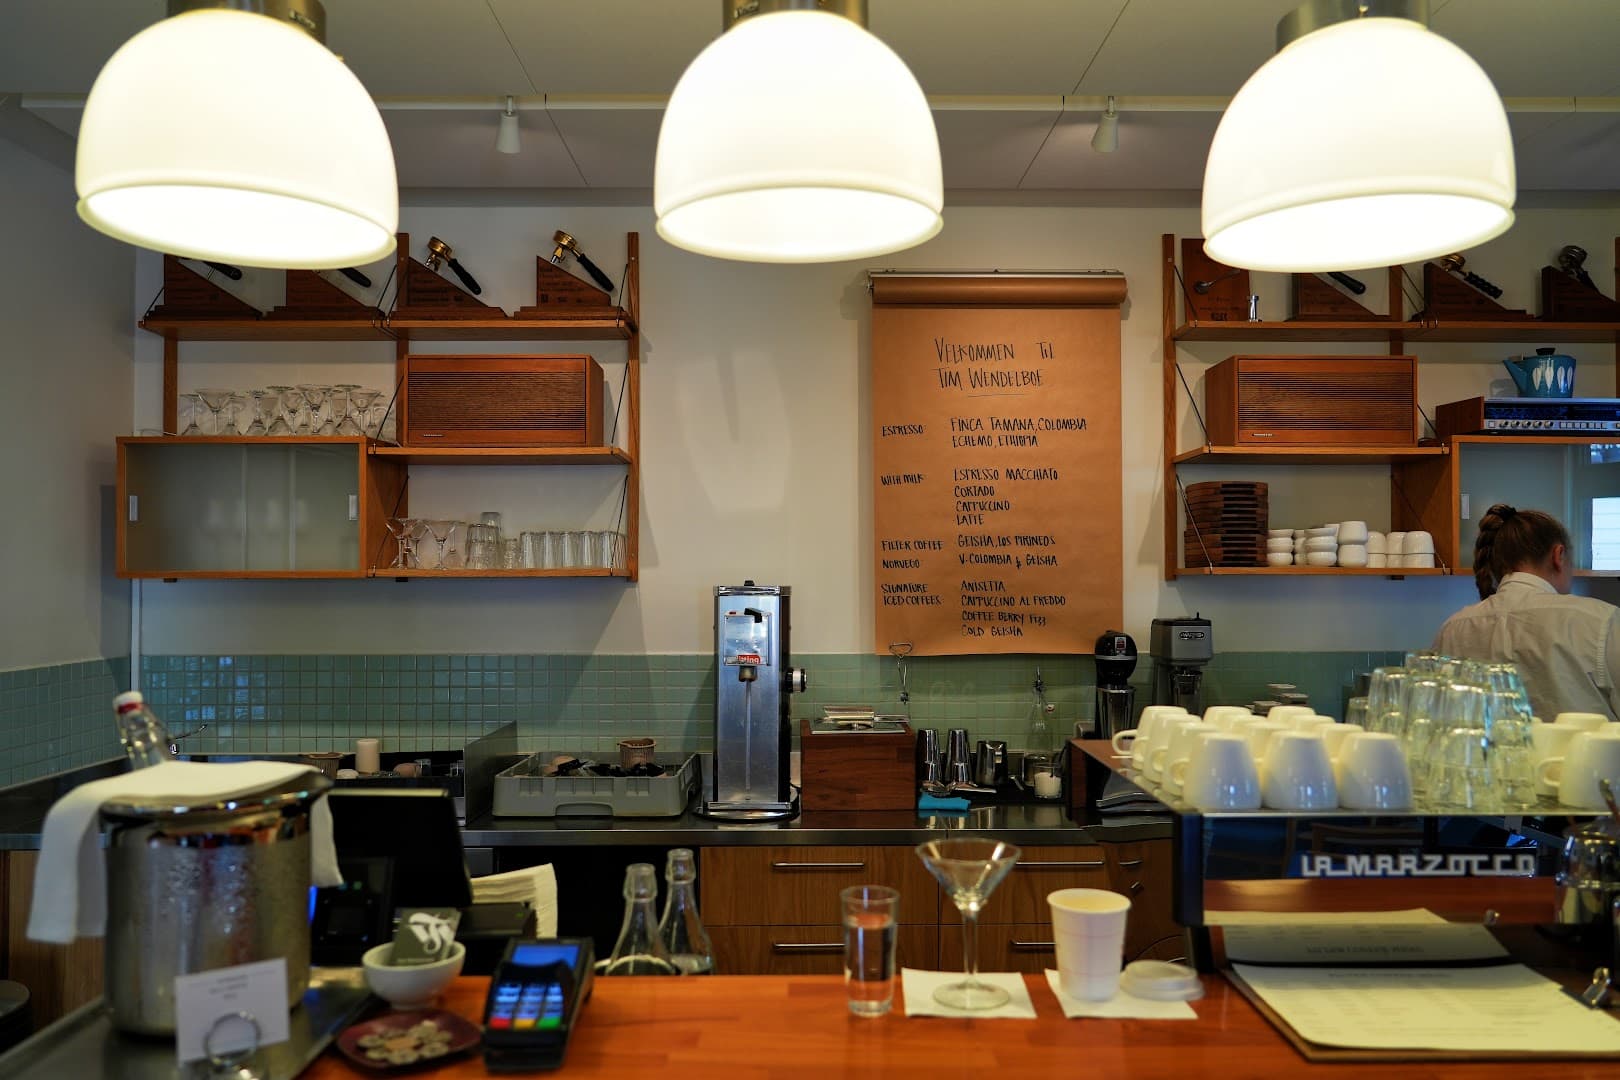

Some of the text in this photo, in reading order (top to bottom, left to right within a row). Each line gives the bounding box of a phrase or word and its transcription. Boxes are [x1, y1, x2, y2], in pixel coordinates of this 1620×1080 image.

[934, 337, 1014, 364] VELKOMMEN
[931, 367, 1046, 391] TIM WENDELBOE
[882, 424, 925, 437] ESPRESSO
[951, 417, 984, 432] FINCA
[881, 473, 924, 486] WITH MILK
[954, 467, 1059, 481] ESPRESSO MACCHIATO
[954, 486, 995, 498] CORTADO
[956, 501, 1010, 512] CAPPUCCINO
[956, 514, 985, 526] LATTE
[882, 540, 944, 551] FILTER COFFEE
[1026, 553, 1058, 567] GEISHA
[881, 583, 928, 593] SIGNATURE
[961, 580, 1006, 592] ANISETTA
[883, 595, 942, 606] ICED COFFEES
[961, 594, 1066, 607] CAPPUCCINO AL FREDDO
[962, 610, 994, 621] COFFEE
[998, 611, 1025, 625] BERRY
[961, 624, 1023, 637] COLD GEISHA
[1302, 854, 1535, 877] LA MARZOCCO
